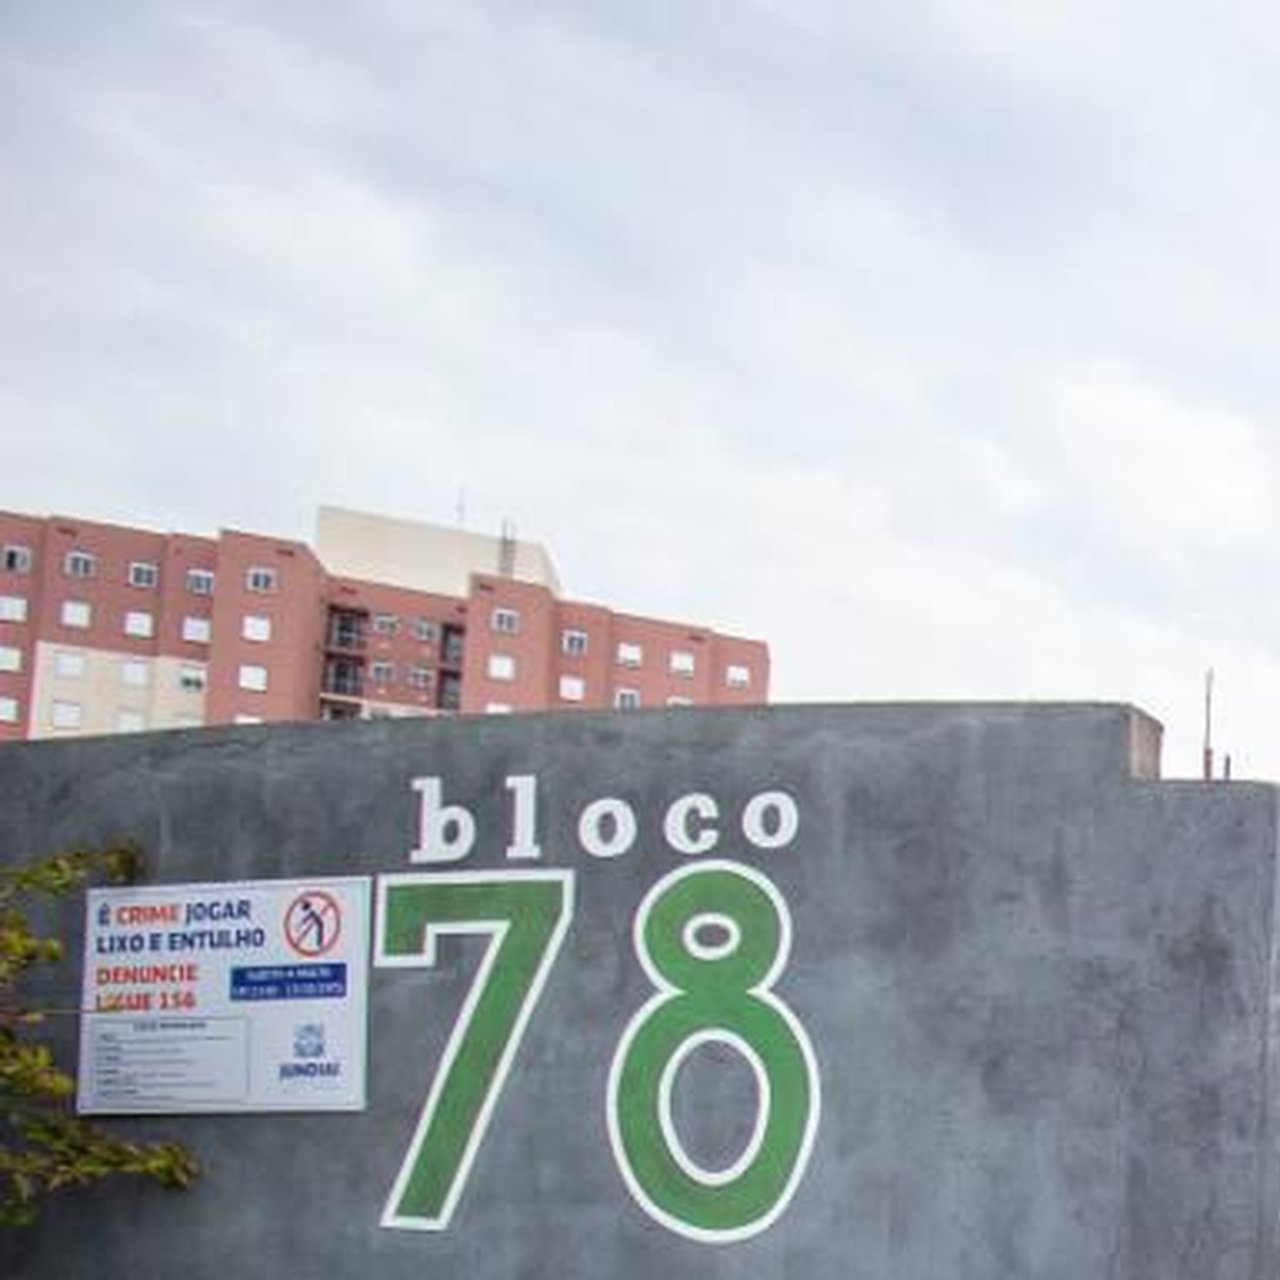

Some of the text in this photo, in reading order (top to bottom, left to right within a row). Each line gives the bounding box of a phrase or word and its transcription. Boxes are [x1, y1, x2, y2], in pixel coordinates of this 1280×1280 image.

[410, 775, 799, 864] bloco
[116, 904, 179, 926] CRIME
[185, 900, 251, 925] JOGAR
[96, 928, 266, 954] LIXO E ENTULHO
[96, 963, 199, 986] DENUNCIE
[374, 859, 821, 1244] 78
